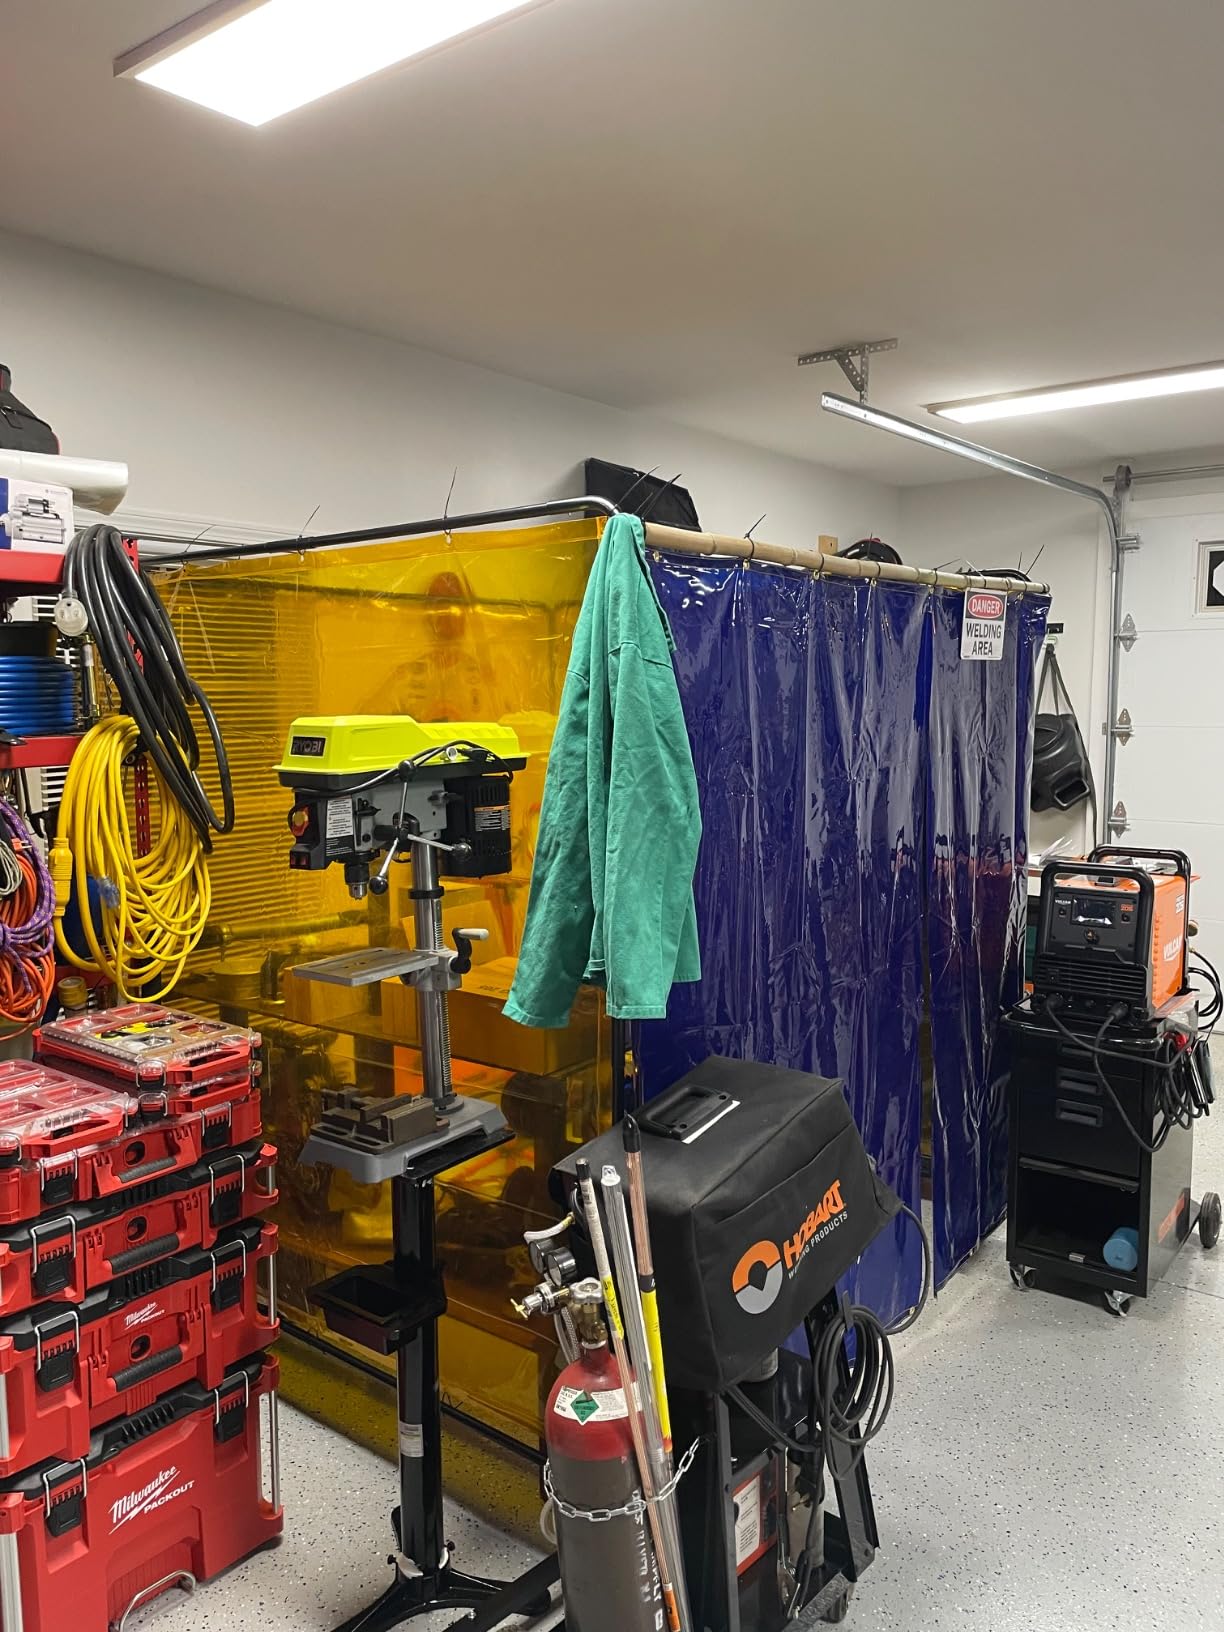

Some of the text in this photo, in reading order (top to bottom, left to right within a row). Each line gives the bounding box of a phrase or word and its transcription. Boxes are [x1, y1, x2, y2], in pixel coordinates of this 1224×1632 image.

[971, 599, 1001, 614] DANGER
[966, 622, 1002, 639] WELDING
[971, 641, 993, 656] AREA
[292, 739, 323, 753] RYOBI
[783, 1179, 845, 1270] HOBART
[810, 1211, 848, 1248] PRODUCTS
[124, 1301, 157, 1326] Milwaukee
[108, 1466, 177, 1524] Milwaukee
[143, 1479, 195, 1514] PACKOUT
